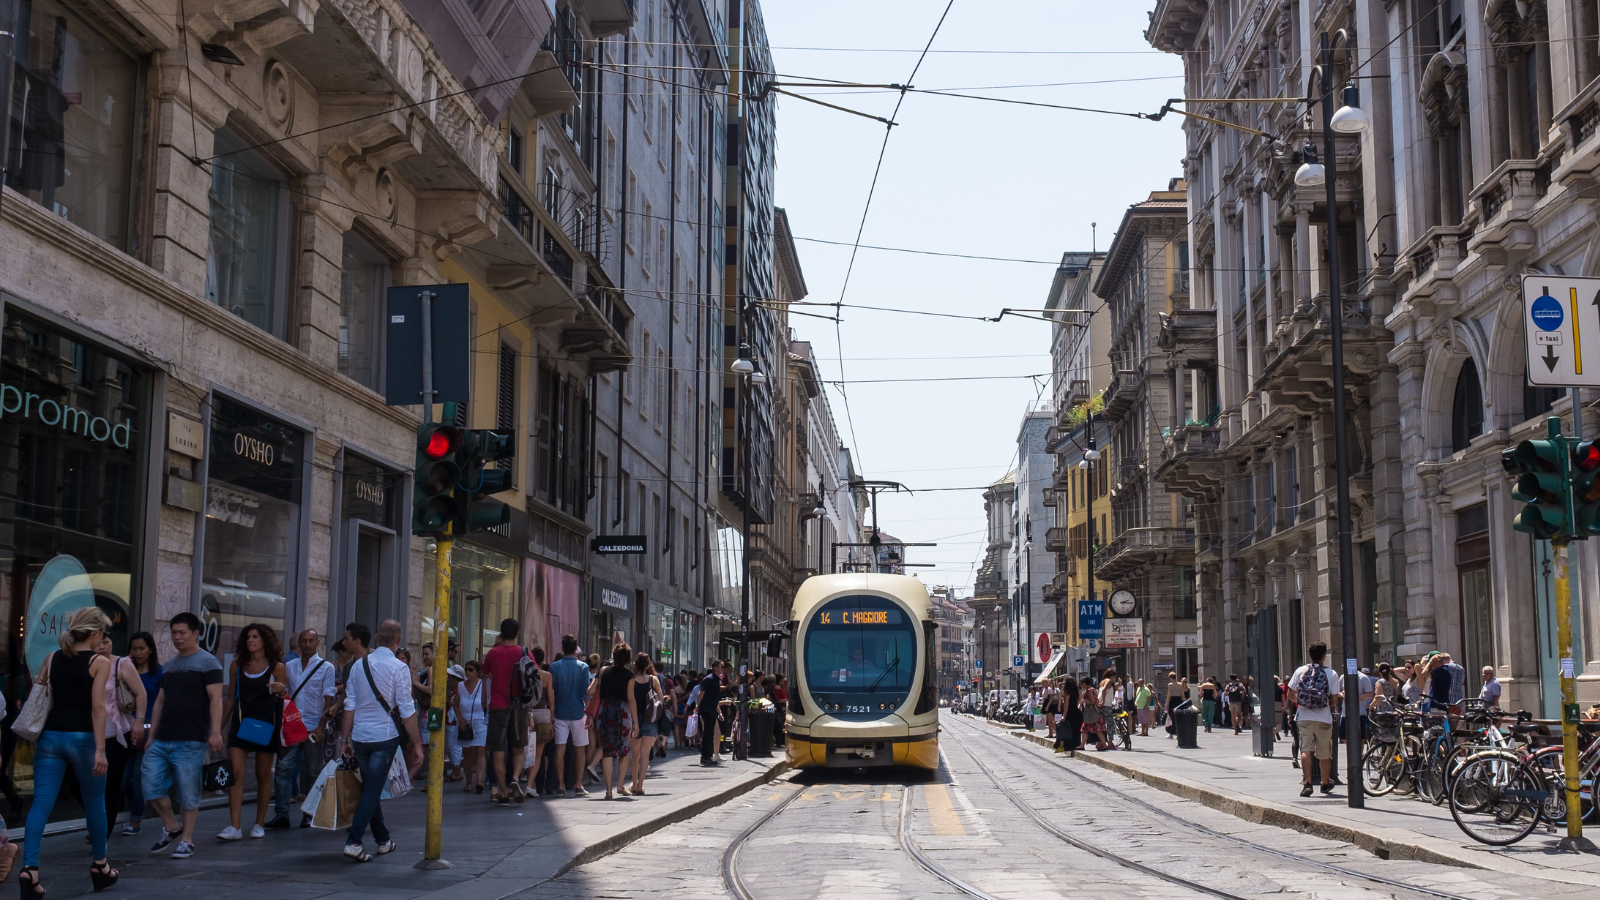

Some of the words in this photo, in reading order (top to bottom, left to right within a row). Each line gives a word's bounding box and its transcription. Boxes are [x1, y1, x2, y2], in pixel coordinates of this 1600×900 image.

[0, 383, 130, 449] promod
[176, 436, 198, 450] TORINO
[234, 433, 274, 466] OYSHO
[356, 480, 384, 506] OYSHO
[602, 588, 628, 611] CALZEDONIA
[820, 612, 831, 624] 14
[842, 611, 850, 624] C.
[852, 611, 888, 624] MAGGIORE
